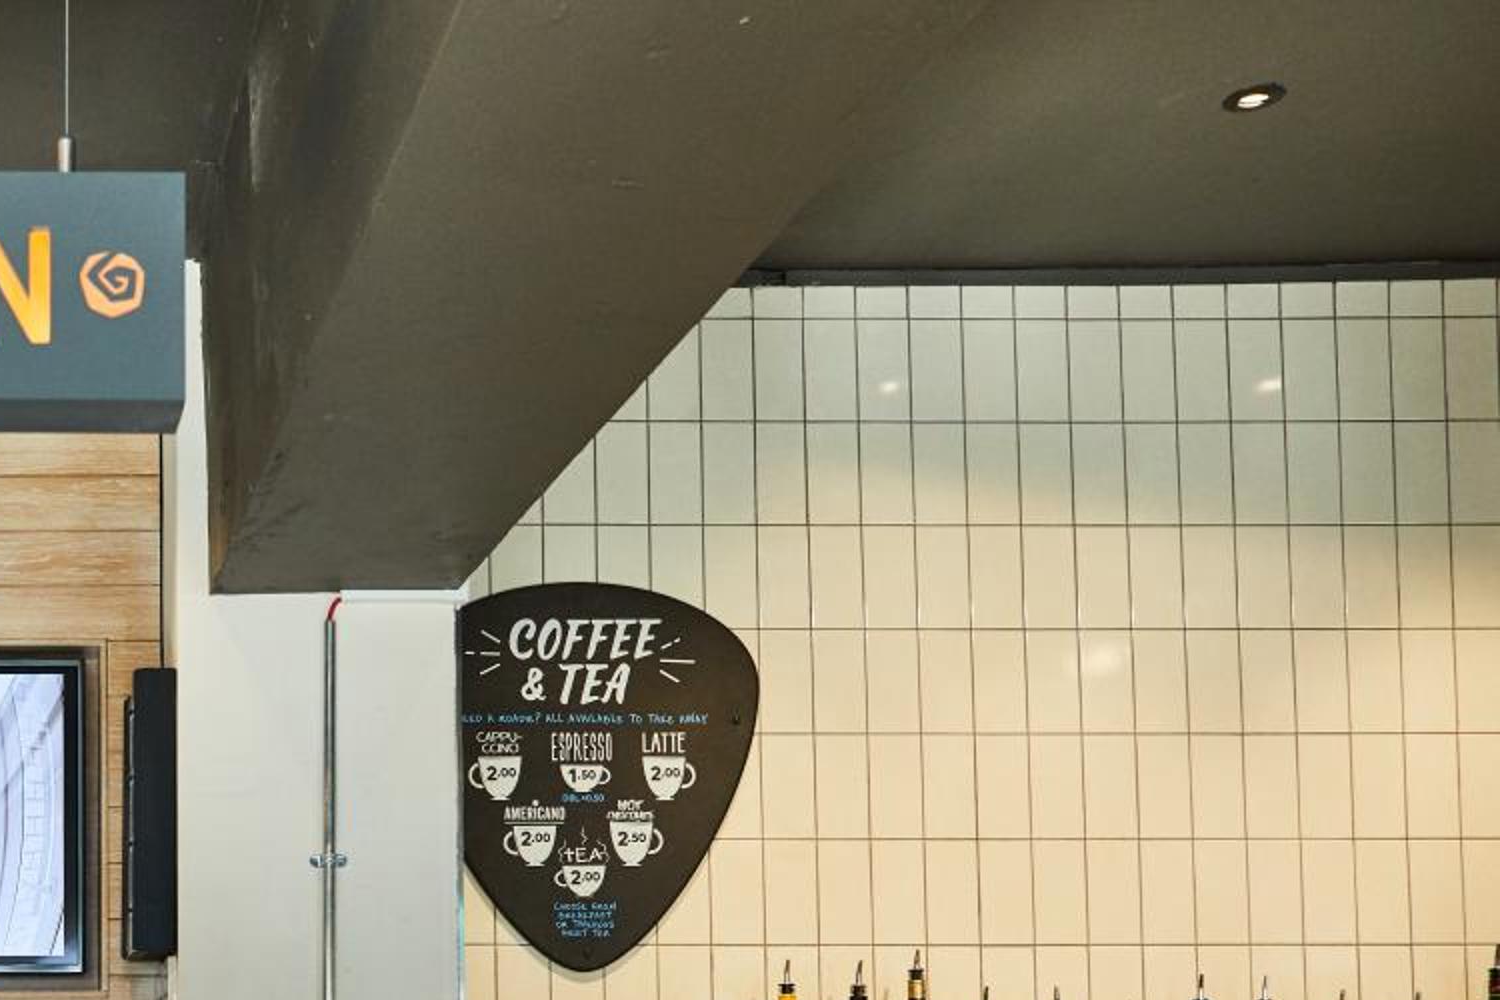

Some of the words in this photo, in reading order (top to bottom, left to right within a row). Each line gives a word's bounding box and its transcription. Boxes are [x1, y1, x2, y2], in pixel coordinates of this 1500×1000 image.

[509, 617, 662, 661] COFFEE
[520, 666, 547, 701] &
[558, 663, 632, 705] TEA
[551, 732, 614, 762] ESPRESSO
[642, 732, 687, 754] LATTE
[486, 766, 517, 781] 2.00
[568, 768, 597, 783] 1.50
[650, 766, 681, 781] 2.00
[504, 803, 566, 821] AMERICANO
[521, 832, 550, 847] 2.00
[618, 832, 647, 847] 2.50
[570, 870, 601, 885] 2.00
